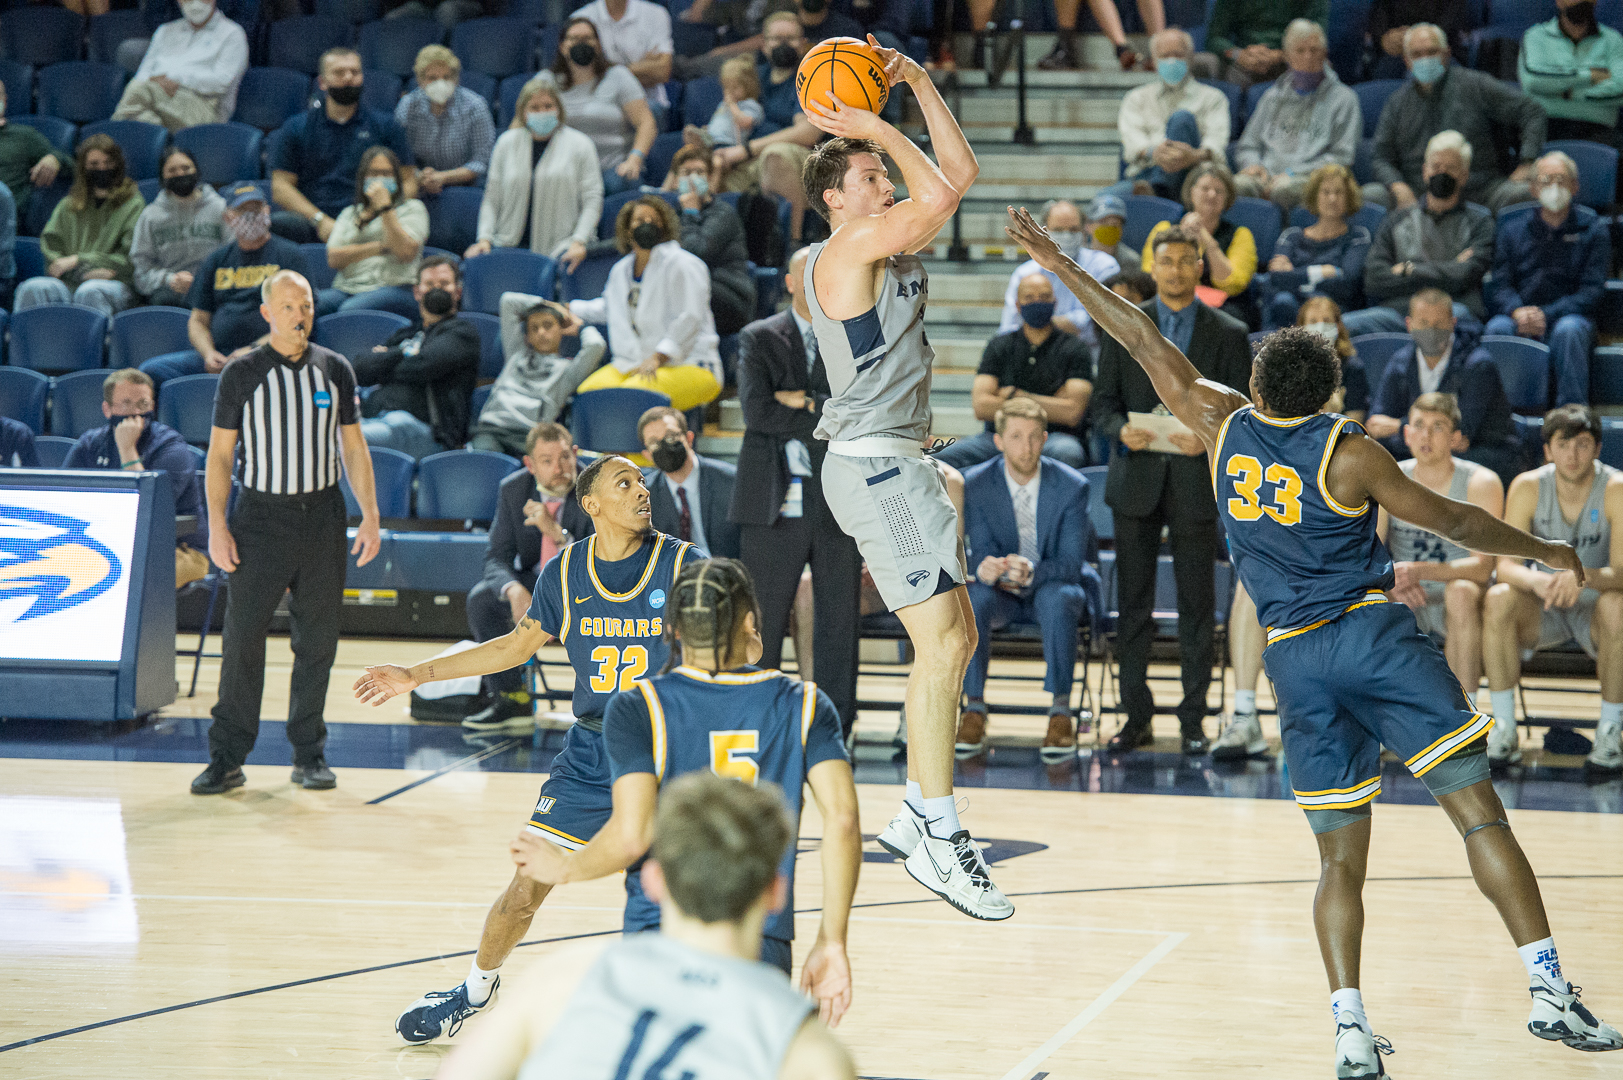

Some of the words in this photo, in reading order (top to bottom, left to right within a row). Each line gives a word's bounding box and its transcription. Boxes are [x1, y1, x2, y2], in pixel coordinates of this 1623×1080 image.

[1226, 453, 1304, 526] 33
[651, 597, 666, 605] NCAA
[580, 617, 663, 637] COUGARS
[589, 645, 649, 694] 32
[709, 729, 760, 788] 5
